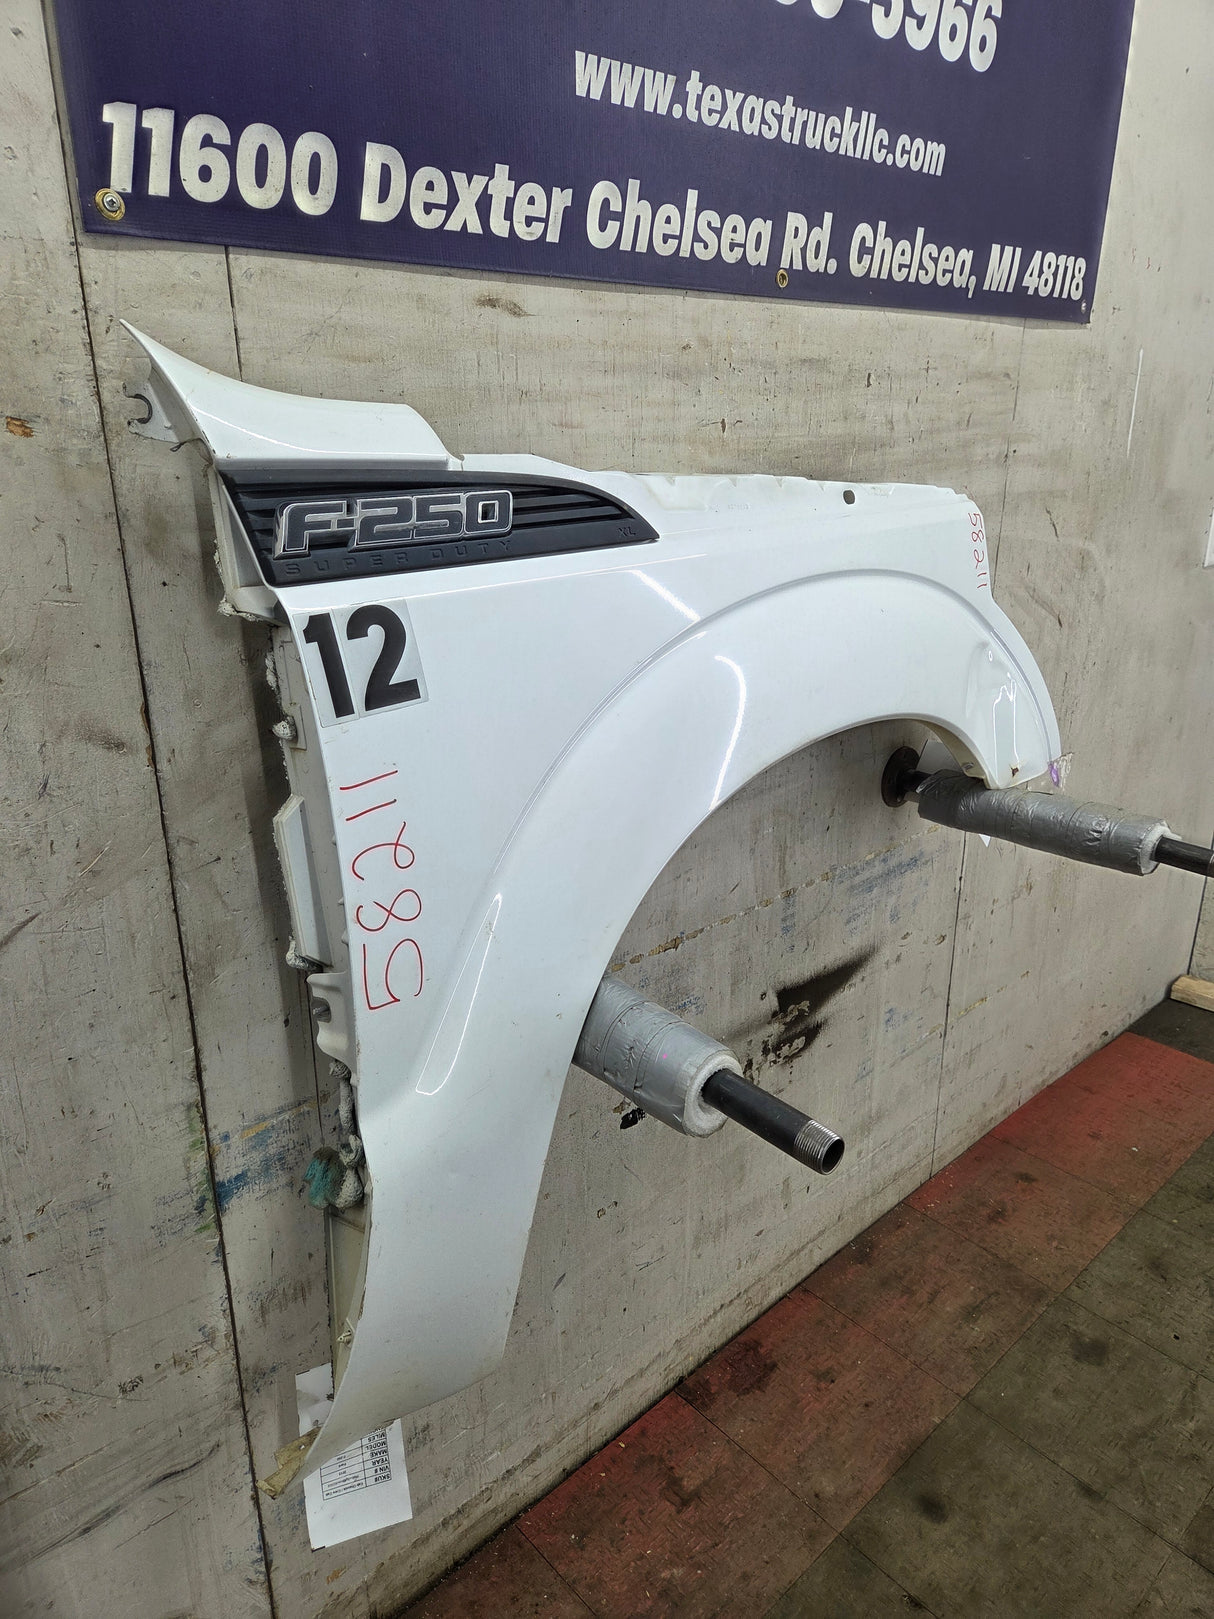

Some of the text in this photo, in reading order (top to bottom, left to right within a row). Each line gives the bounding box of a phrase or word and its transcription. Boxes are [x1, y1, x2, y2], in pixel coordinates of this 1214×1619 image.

[575, 51, 945, 176] www.texastruckllc.com
[102, 102, 1086, 300] 11600 Dexter Chelsea Rd. Chelsea, MI 48118
[273, 489, 513, 560] F-250
[285, 540, 512, 577] SUPER DUTY
[968, 512, 987, 589] 58211
[302, 604, 421, 718] 12
[339, 770, 422, 1010] 58211
[365, 1440, 386, 1450] MODEL
[370, 1448, 387, 1458] MAKE
[371, 1457, 388, 1466] YEAR
[379, 1465, 389, 1473] VIN
